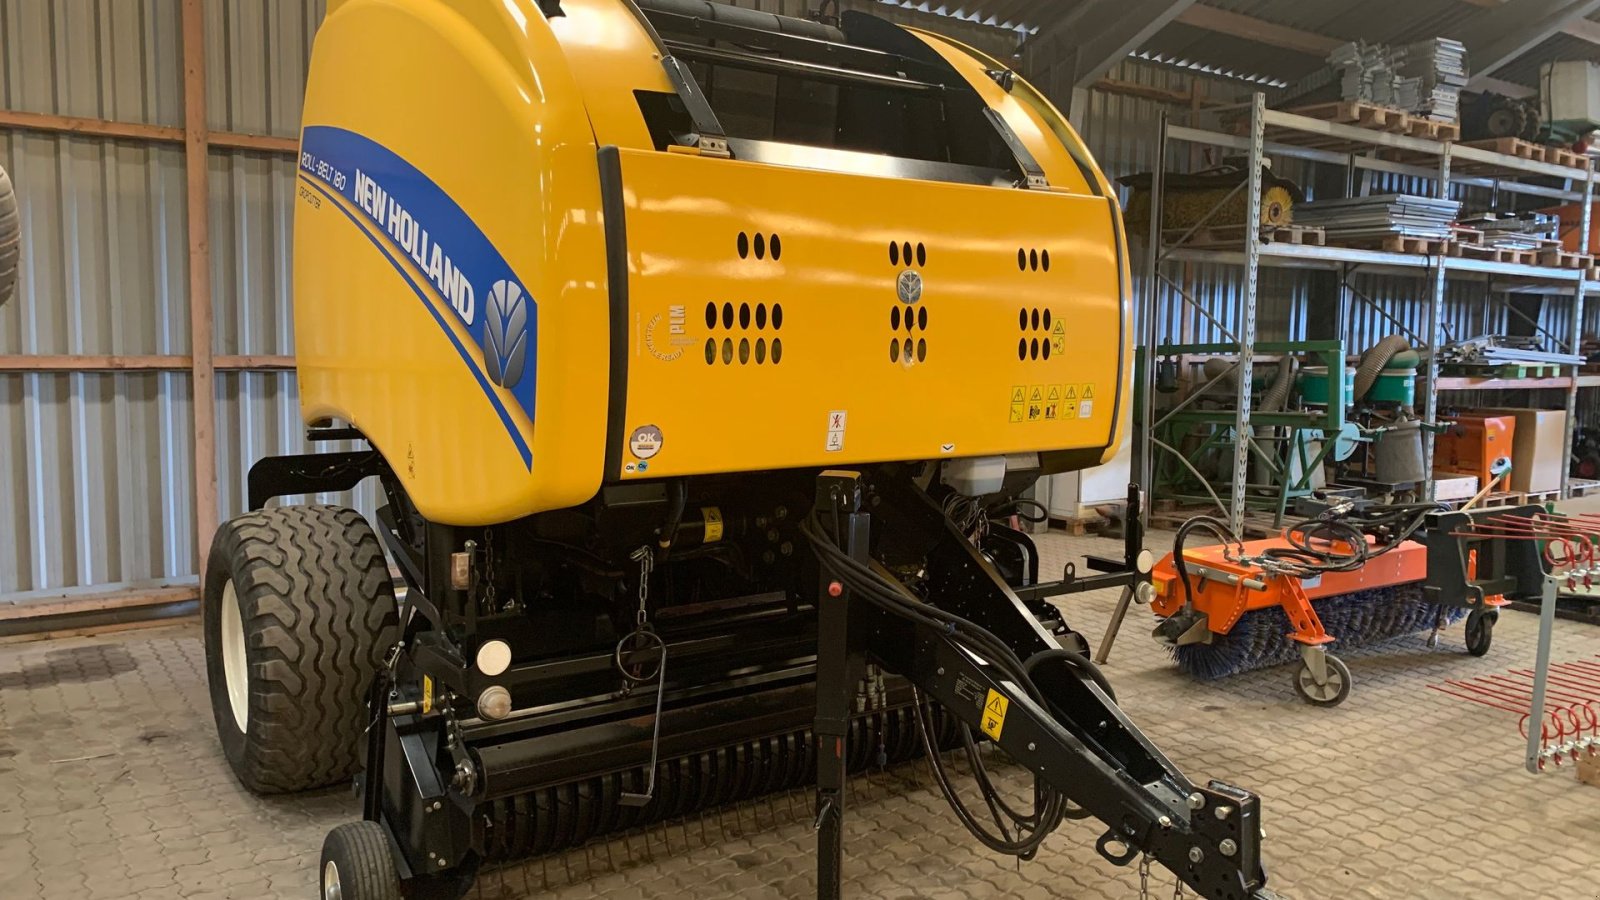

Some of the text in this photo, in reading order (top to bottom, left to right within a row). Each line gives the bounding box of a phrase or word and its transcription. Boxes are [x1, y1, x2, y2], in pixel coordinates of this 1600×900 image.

[333, 170, 346, 191] 180
[354, 168, 475, 326] NEW HOLLAND
[669, 304, 686, 335] PLM
[637, 432, 656, 442] OK
